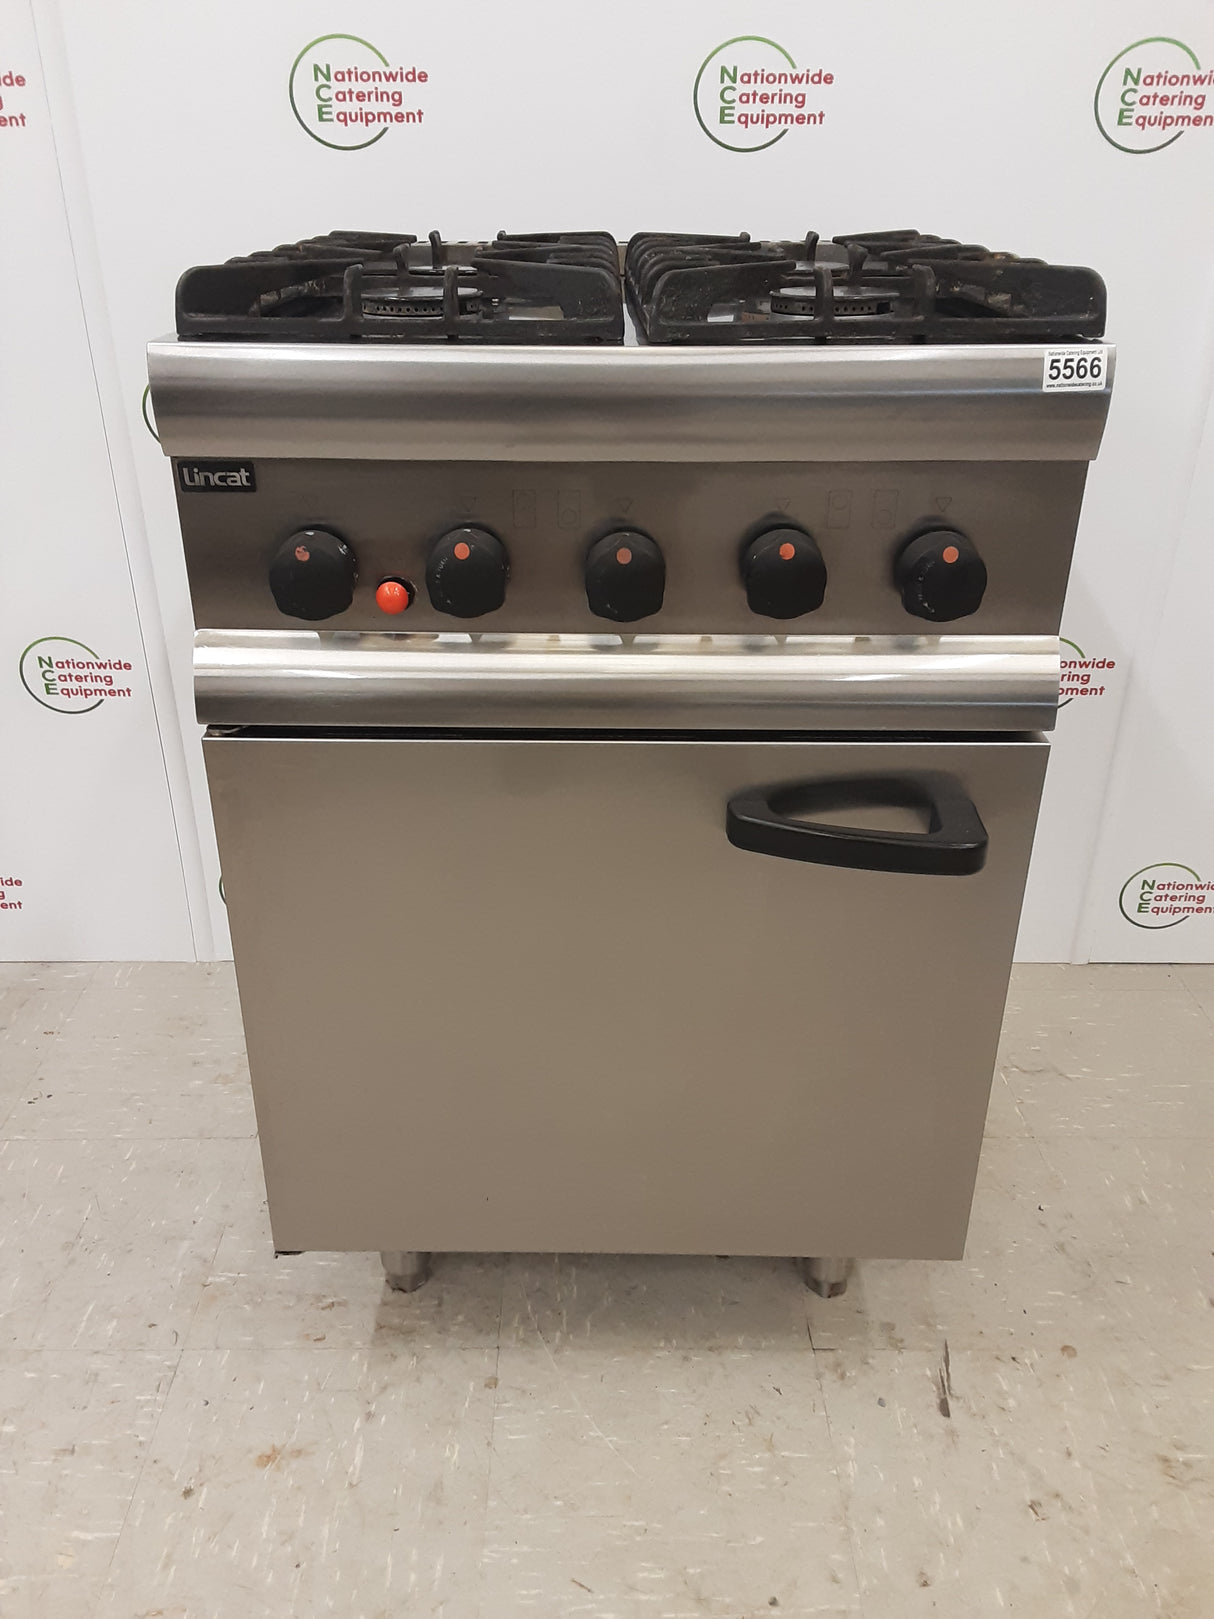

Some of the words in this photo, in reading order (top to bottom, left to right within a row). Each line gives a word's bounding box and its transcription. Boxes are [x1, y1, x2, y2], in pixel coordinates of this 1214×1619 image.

[313, 63, 428, 82] Nationwide
[719, 65, 834, 85] Nationwide
[1122, 67, 1214, 86] Nationwi
[315, 84, 403, 107] Catering
[719, 86, 806, 109] Catering
[1120, 88, 1206, 110] Catering
[317, 104, 424, 127] Equipment
[719, 106, 825, 129] Equipment
[1048, 356, 1102, 380] 5566
[182, 467, 251, 486] Lincat
[37, 656, 132, 670] Nationwide
[41, 670, 113, 686] Catering
[44, 683, 132, 699] Equipment
[1139, 891, 1206, 905] Catering
[1137, 902, 1214, 916] Equipmen
